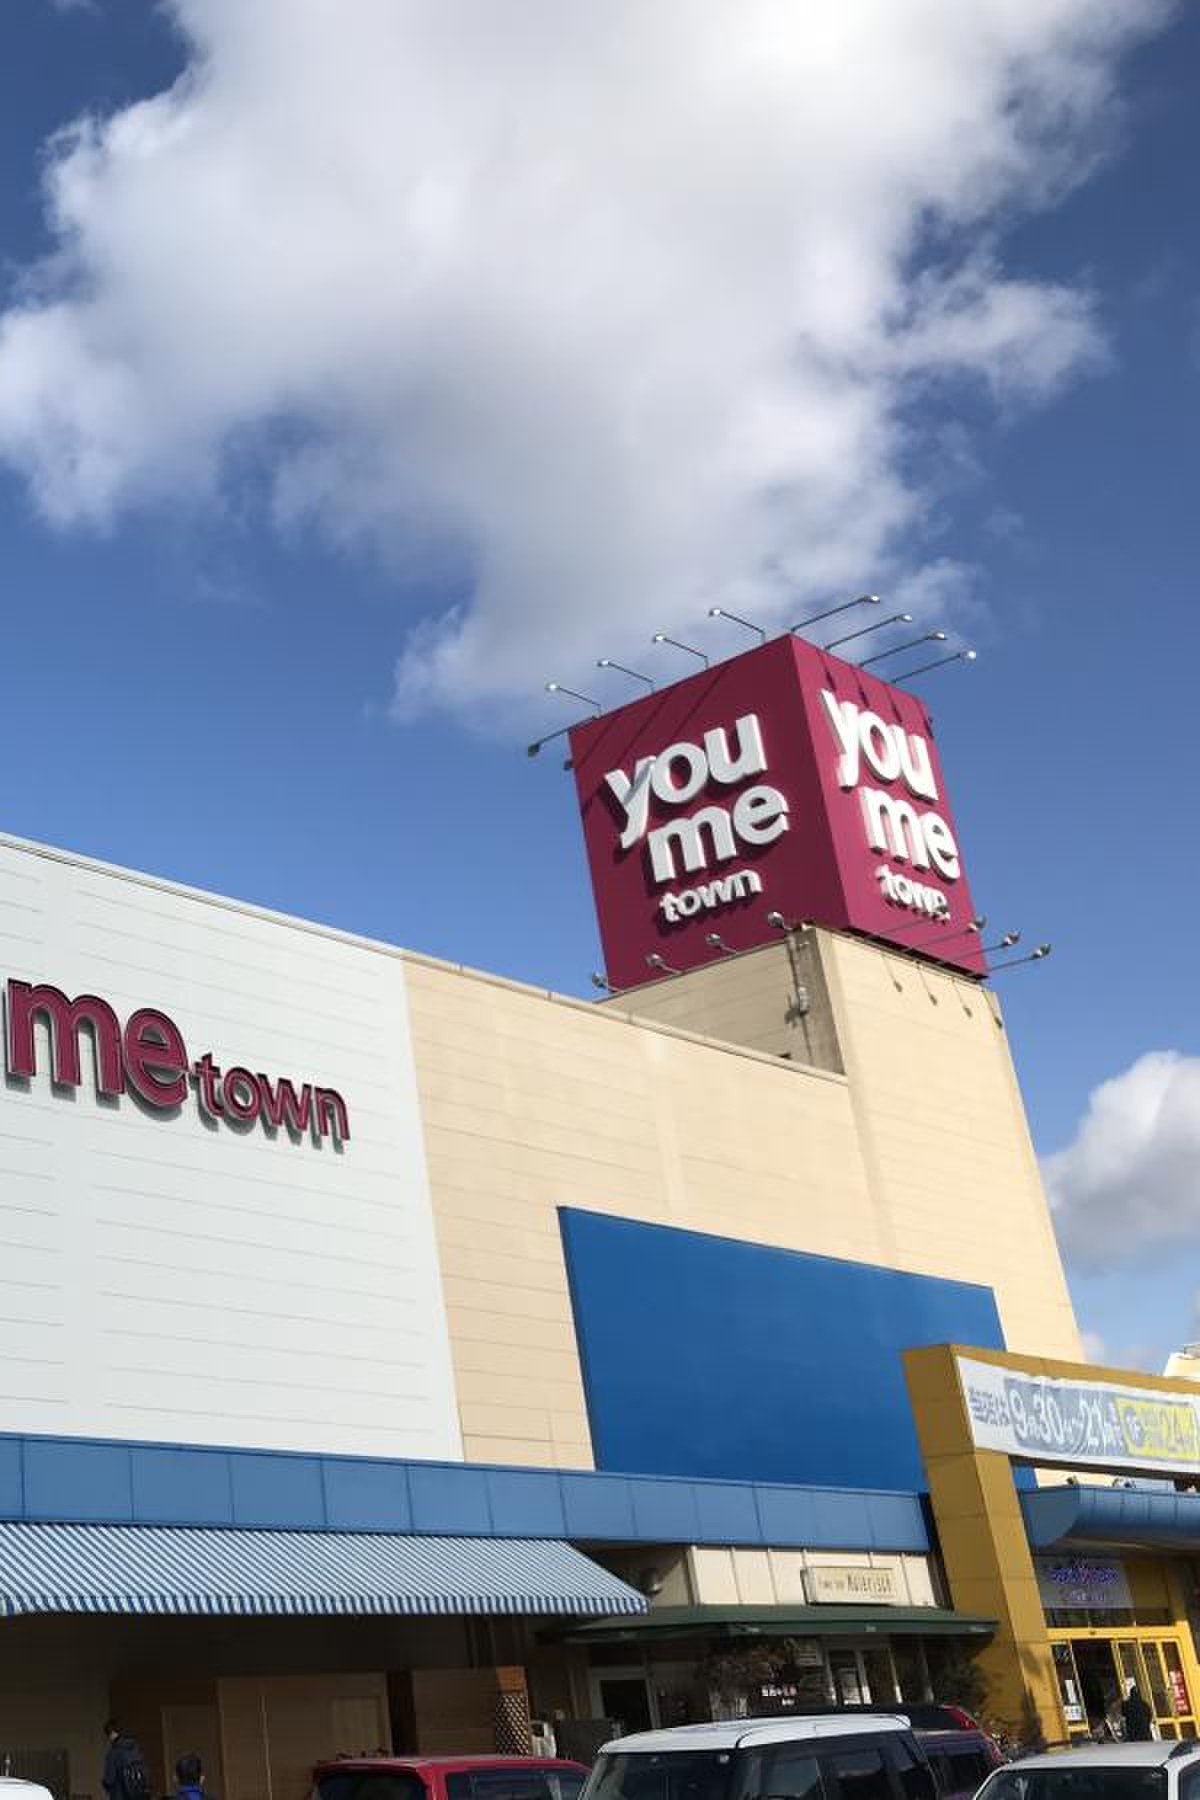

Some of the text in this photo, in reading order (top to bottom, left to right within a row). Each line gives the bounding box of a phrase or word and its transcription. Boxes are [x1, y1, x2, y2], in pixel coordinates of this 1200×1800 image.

[605, 712, 769, 849] you
[820, 687, 939, 801] you
[648, 784, 789, 882] me
[859, 786, 961, 881] me
[659, 868, 762, 923] town
[876, 865, 951, 922] town
[194, 1053, 350, 1141] town
